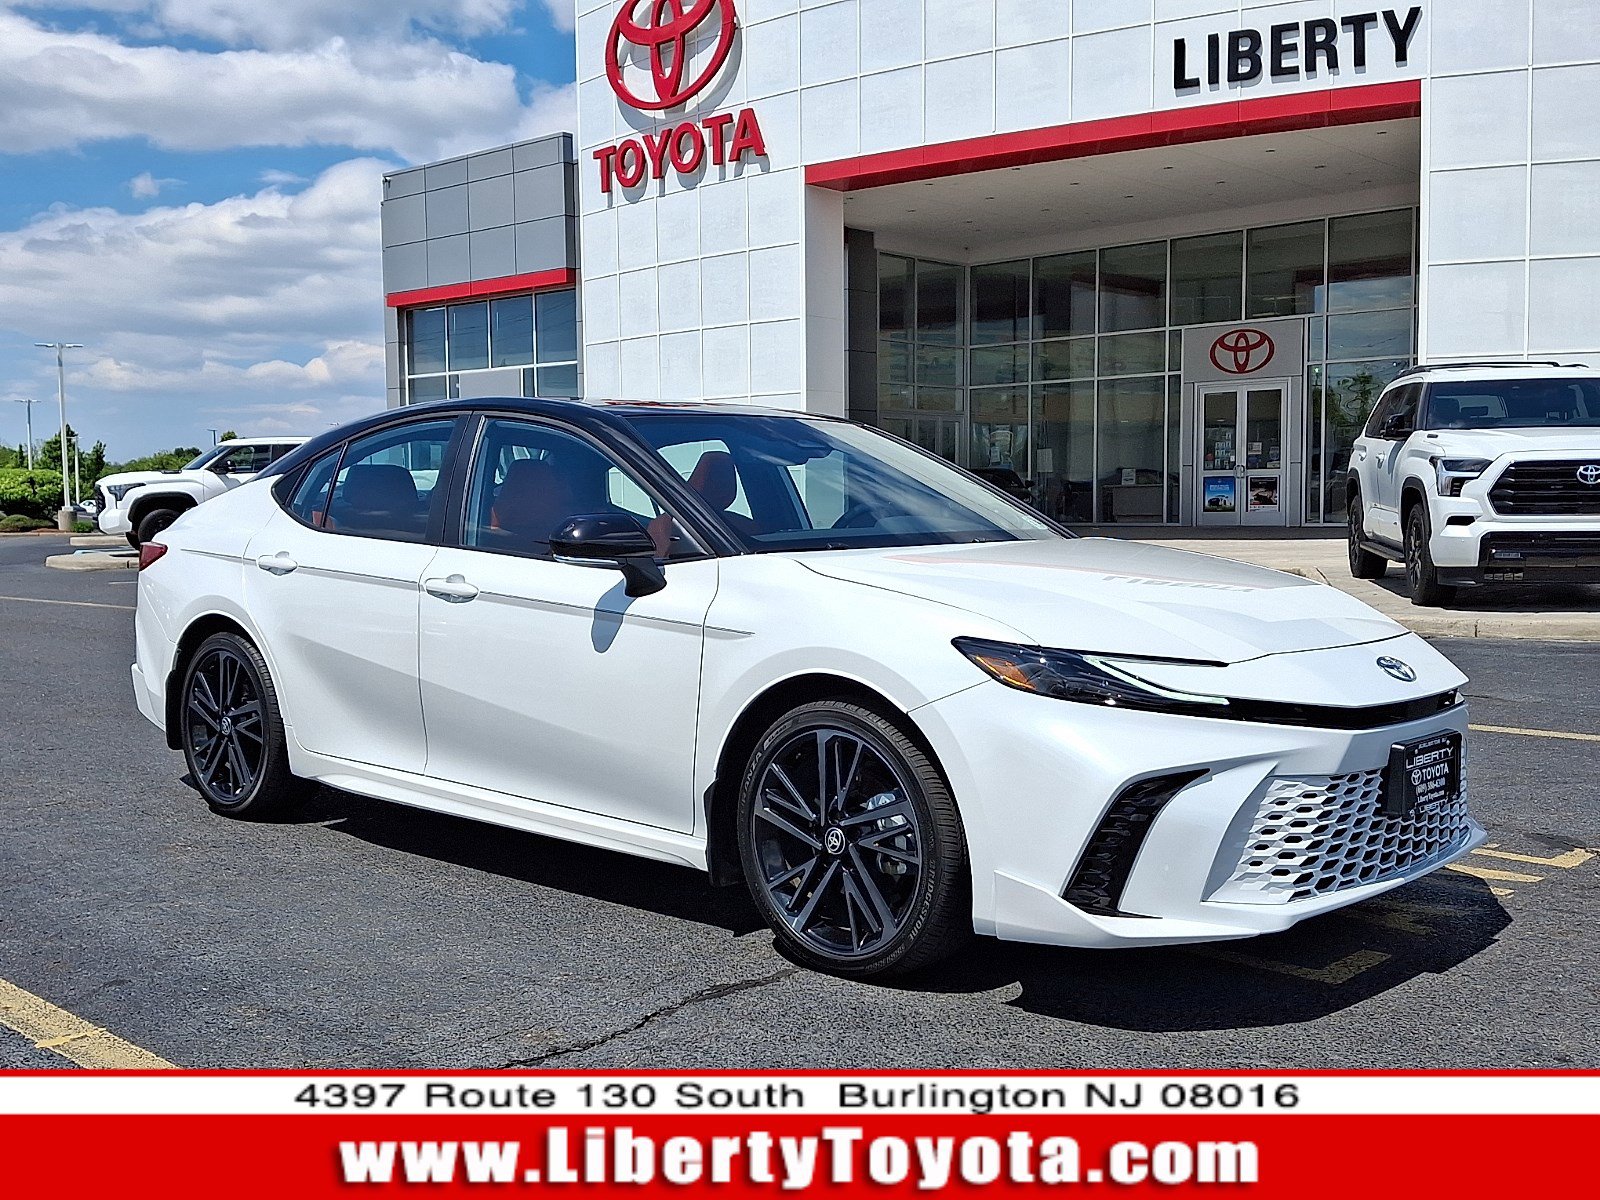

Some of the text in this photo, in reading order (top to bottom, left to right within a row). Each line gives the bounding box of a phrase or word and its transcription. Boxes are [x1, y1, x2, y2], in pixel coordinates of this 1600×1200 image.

[1174, 6, 1422, 90] LIBERTY
[593, 108, 767, 193] TOYOTA
[1407, 747, 1453, 769] LIBERTY
[1422, 762, 1449, 780] TOYOTA
